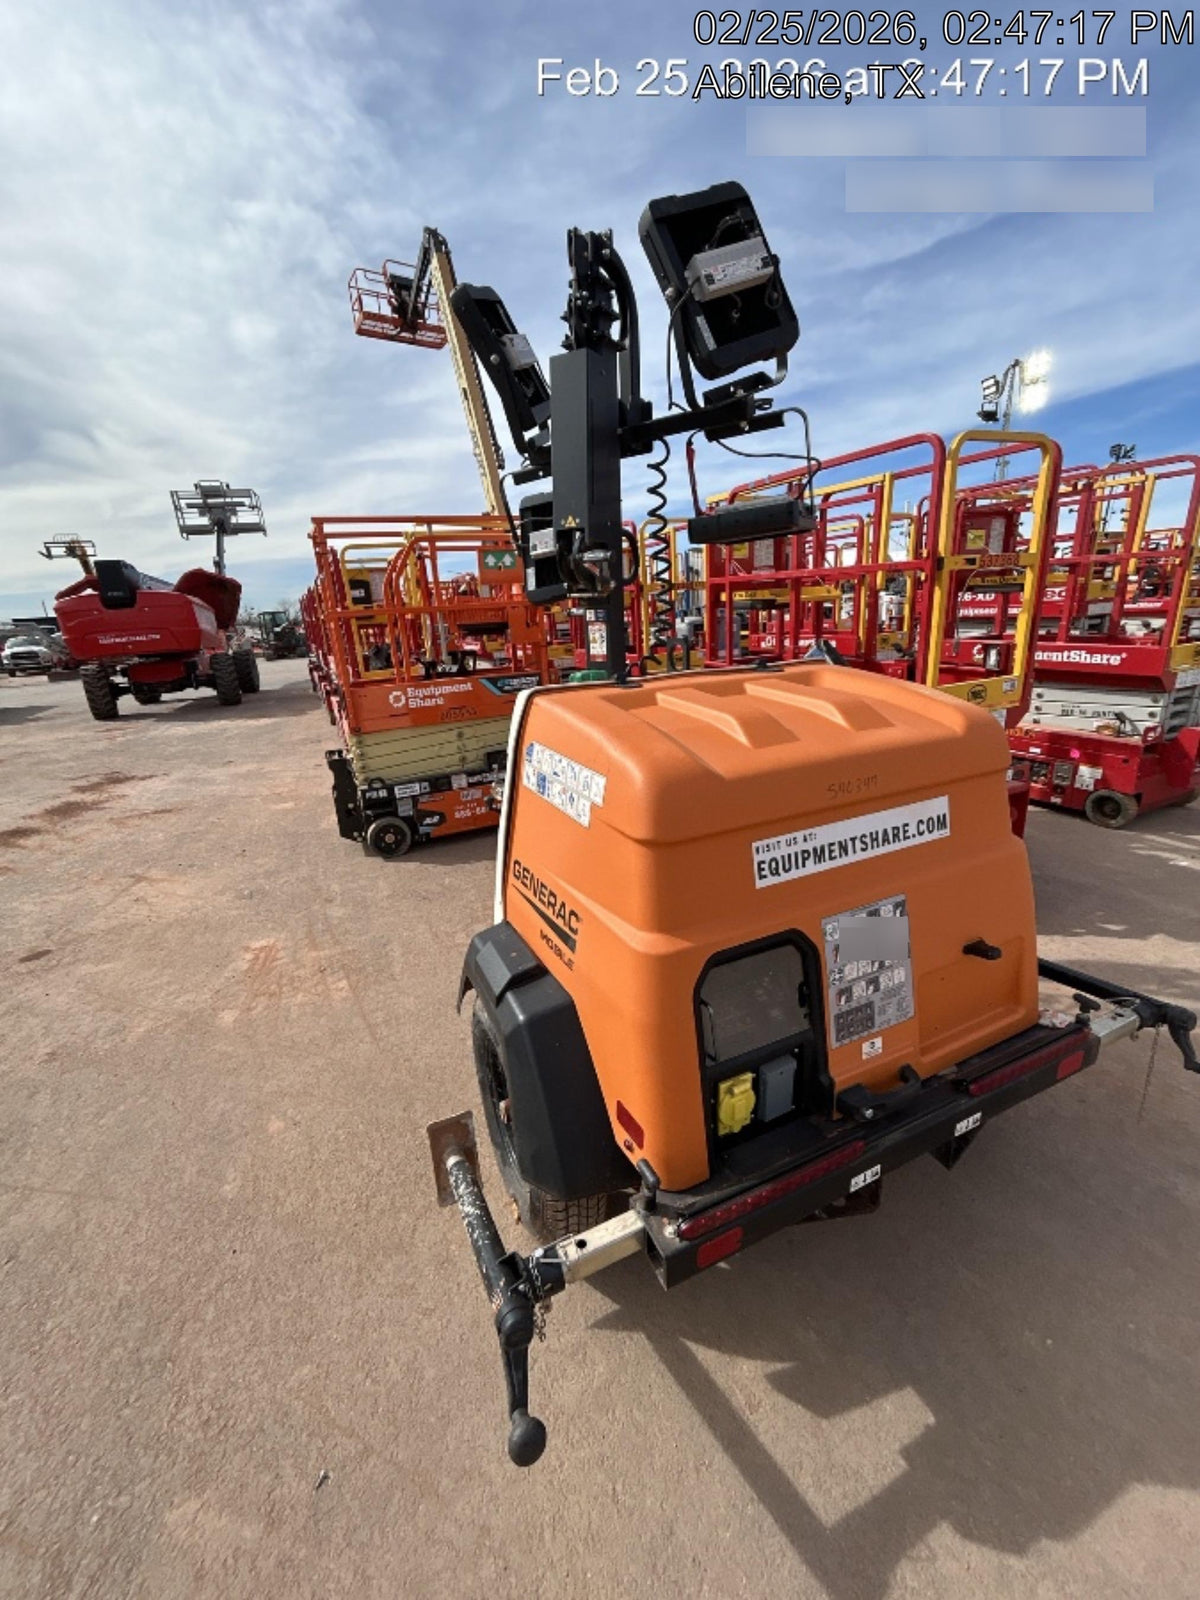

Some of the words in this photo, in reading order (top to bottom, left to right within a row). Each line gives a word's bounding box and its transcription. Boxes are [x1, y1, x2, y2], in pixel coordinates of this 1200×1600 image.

[406, 682, 473, 698] Equipment
[408, 696, 445, 709] Share
[755, 840, 781, 855] VISIT
[785, 836, 798, 847] US
[802, 832, 817, 843] AT:
[756, 812, 948, 881] EQUIPMENTSHARE.COM
[512, 859, 579, 936] GENERAC
